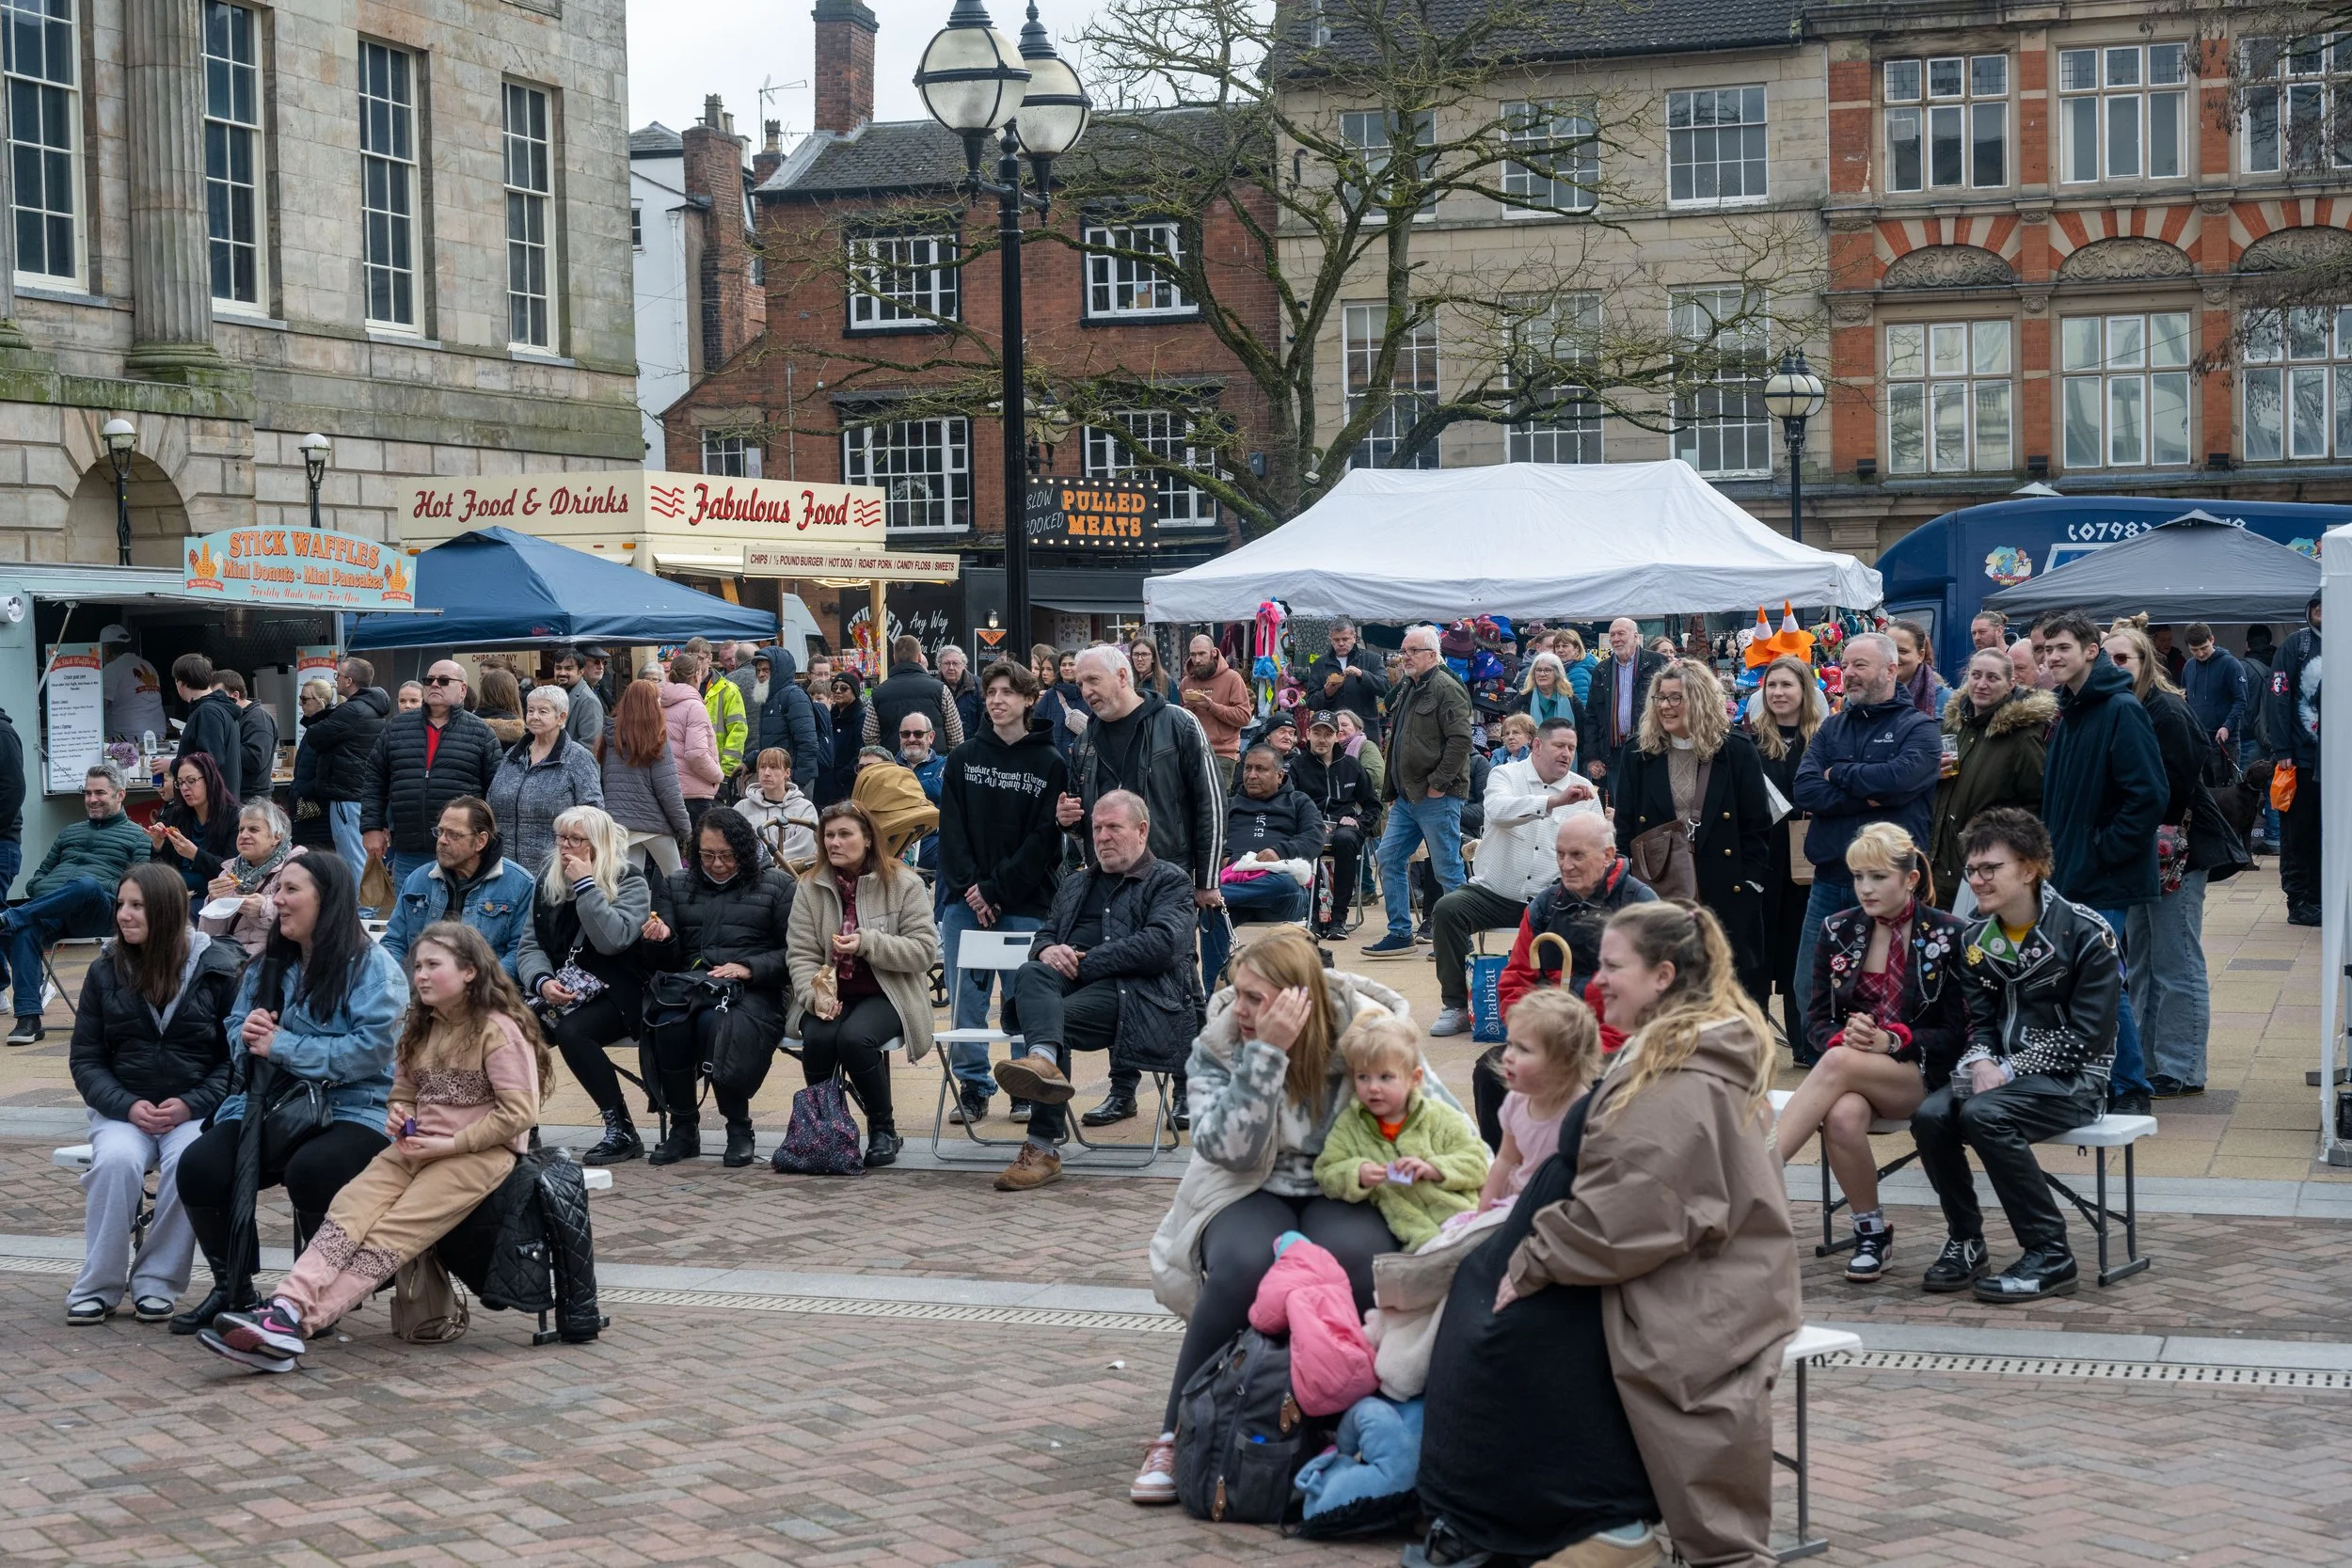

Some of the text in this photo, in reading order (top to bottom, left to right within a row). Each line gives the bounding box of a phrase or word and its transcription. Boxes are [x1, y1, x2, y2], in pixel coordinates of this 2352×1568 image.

[413, 485, 628, 522] Hot Food & Drinks
[689, 483, 850, 531] Fabulous Food
[1026, 488, 1054, 510] SLOW
[1061, 490, 1146, 513] PULLED
[1068, 515, 1141, 537] MEATS
[229, 531, 380, 569] STICK WAFFLES
[750, 553, 768, 565] CHIPS
[779, 556, 800, 567] POUND
[800, 556, 824, 567] BURGER
[828, 558, 840, 568] HOT
[840, 559, 852, 568] DOG
[858, 561, 876, 569] ROAST
[877, 561, 893, 569] PORK
[897, 562, 914, 571] CANDY
[914, 562, 931, 571] FLOSS
[934, 562, 955, 572] SWEETS
[223, 560, 249, 580] Mini
[253, 562, 294, 583] Donuts
[304, 566, 329, 586] Mini
[332, 568, 384, 590] Pancakes
[909, 610, 948, 635] Any Way
[1483, 967, 1498, 1021] habitat
